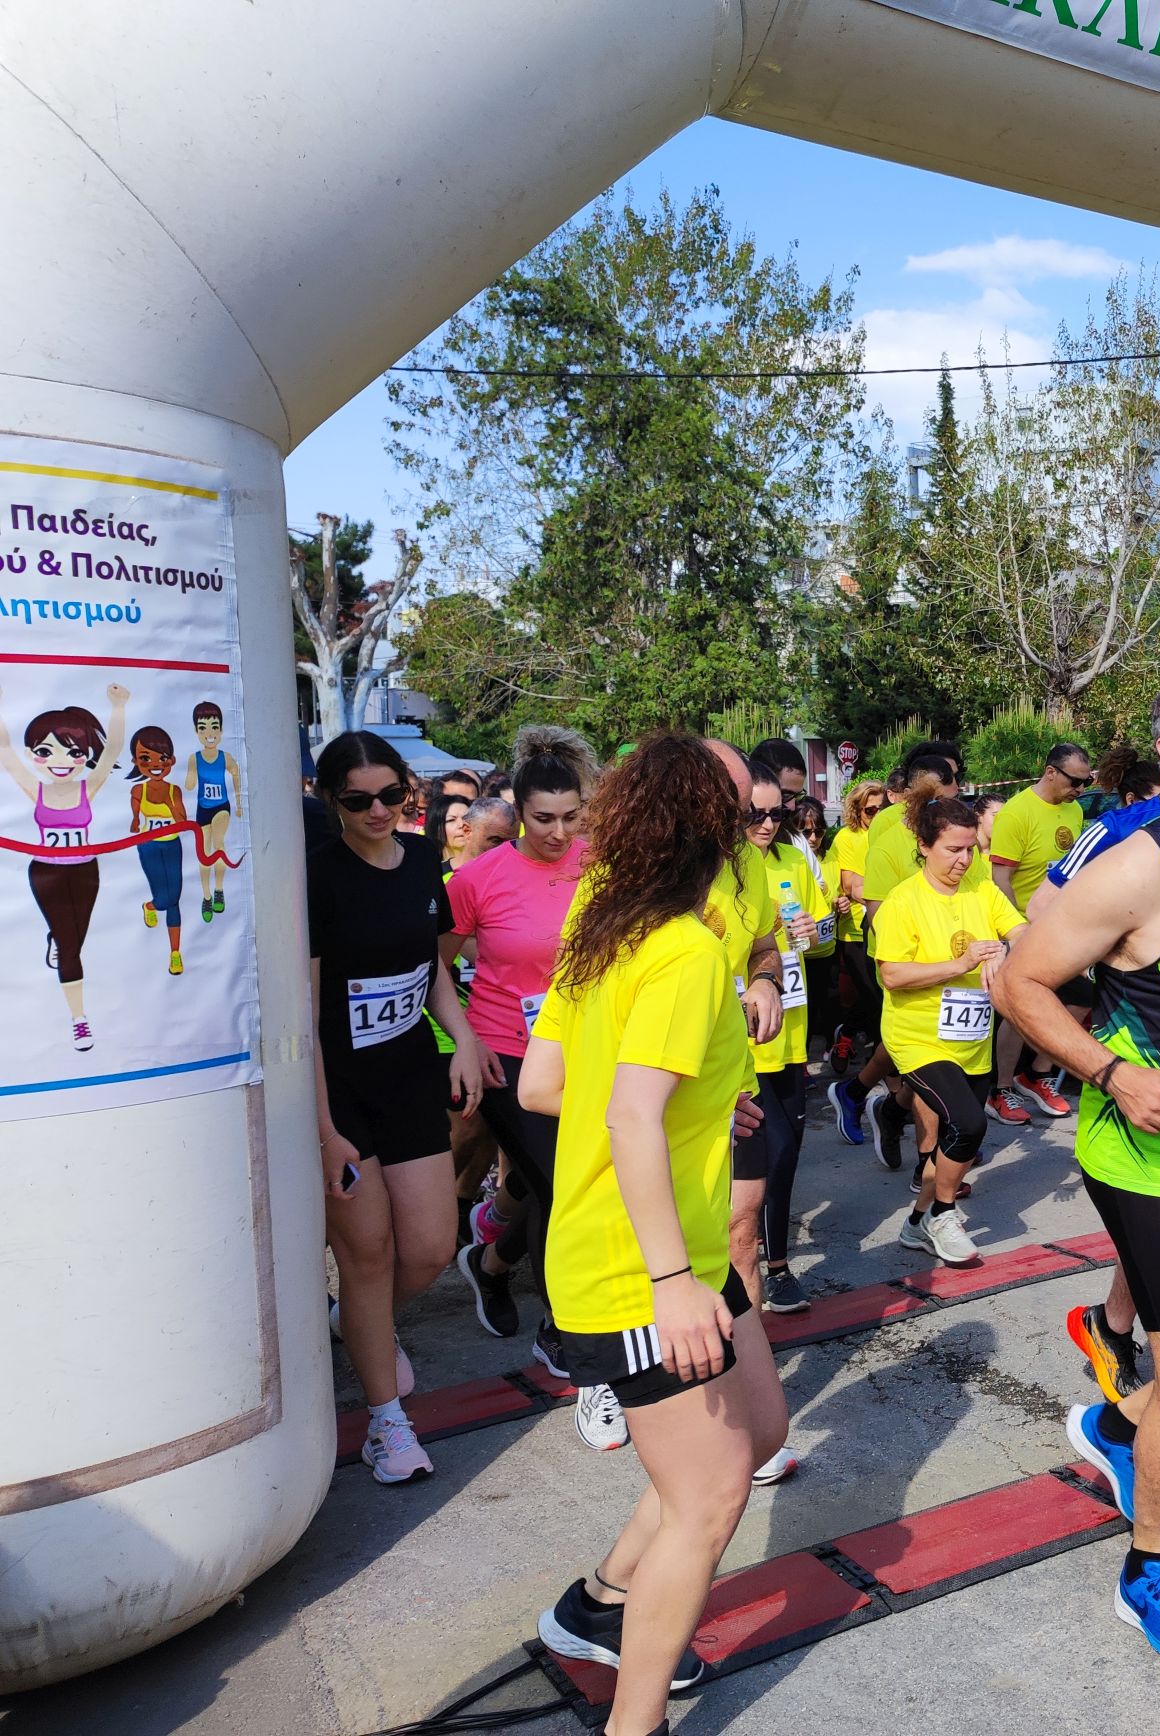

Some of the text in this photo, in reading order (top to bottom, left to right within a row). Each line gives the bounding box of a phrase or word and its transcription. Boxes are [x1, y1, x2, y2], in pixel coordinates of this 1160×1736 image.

[11, 504, 157, 546] Παιδείας,
[0, 547, 223, 594] ύ & Πολιτισμού
[841, 747, 857, 760] STOP
[205, 785, 221, 798] 311
[47, 831, 83, 848] 211
[354, 981, 428, 1031] 1437
[942, 1005, 992, 1028] 1479
